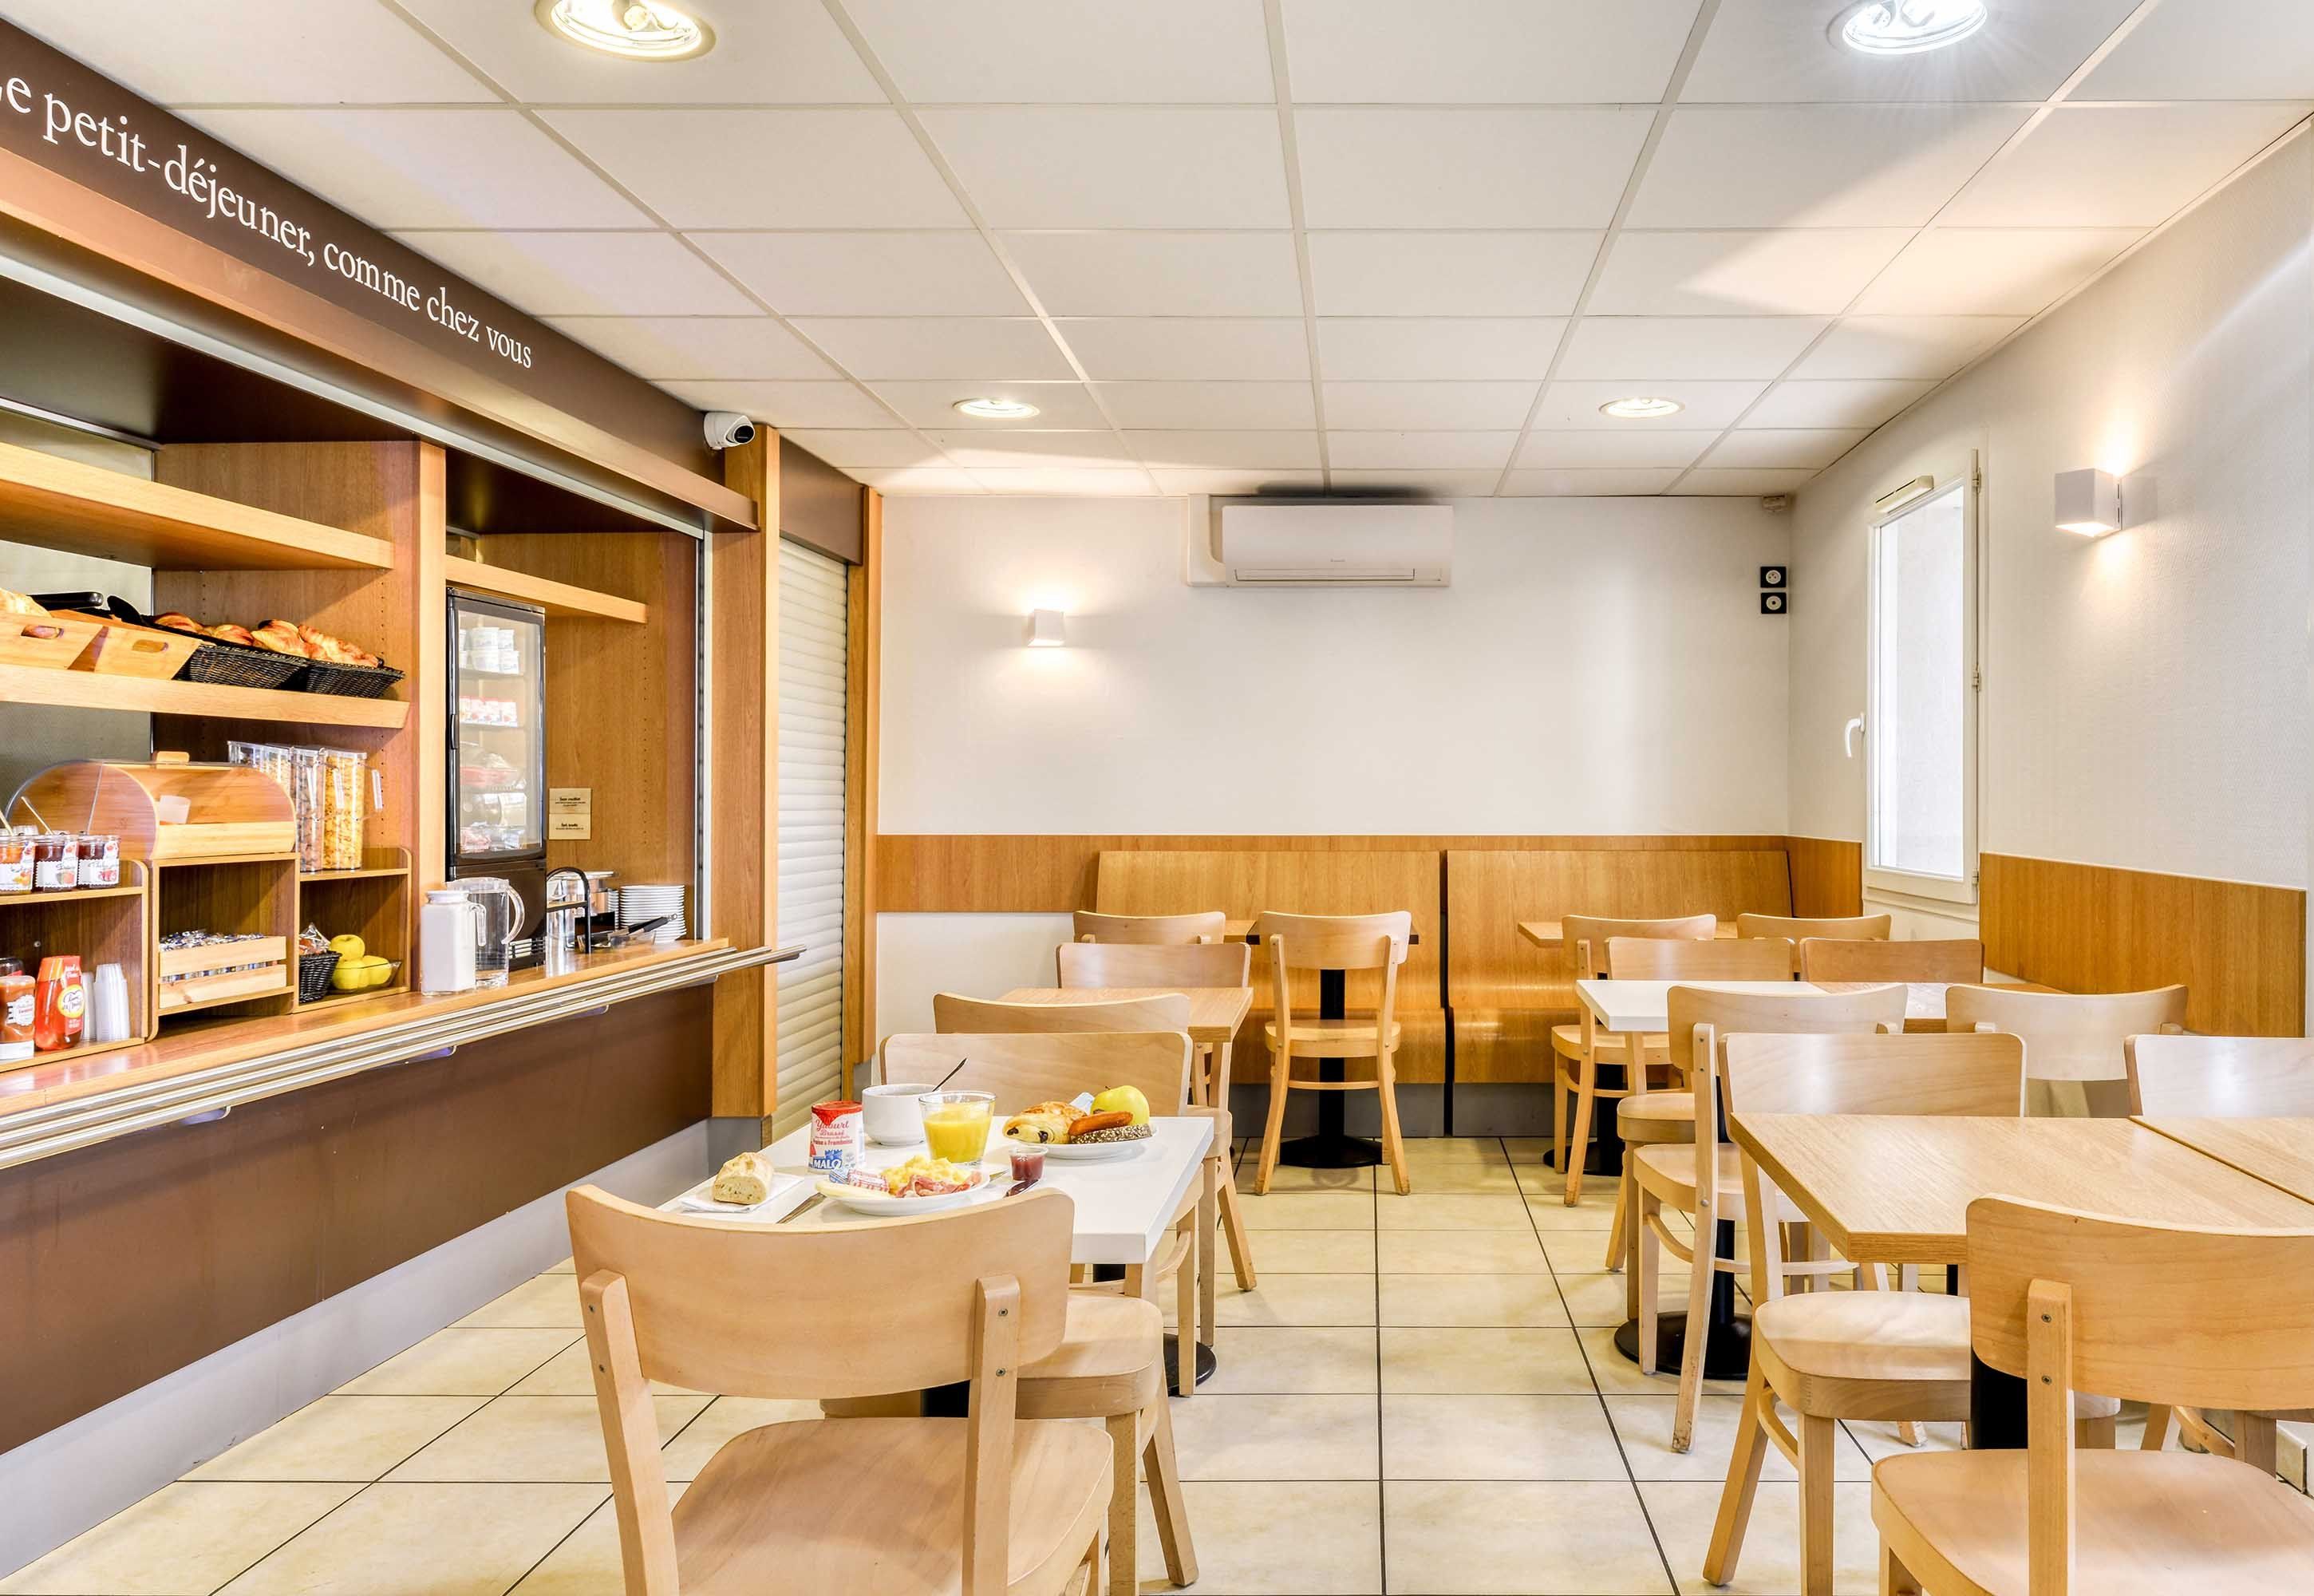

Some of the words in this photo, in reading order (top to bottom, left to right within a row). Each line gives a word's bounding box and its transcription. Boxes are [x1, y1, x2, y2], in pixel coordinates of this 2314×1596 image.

[0, 77, 31, 113] e
[43, 93, 315, 267] petit-déjeuner,
[323, 243, 421, 311] comme
[426, 286, 480, 342] chez
[486, 326, 531, 369] vous
[814, 1159, 841, 1169] MALO
